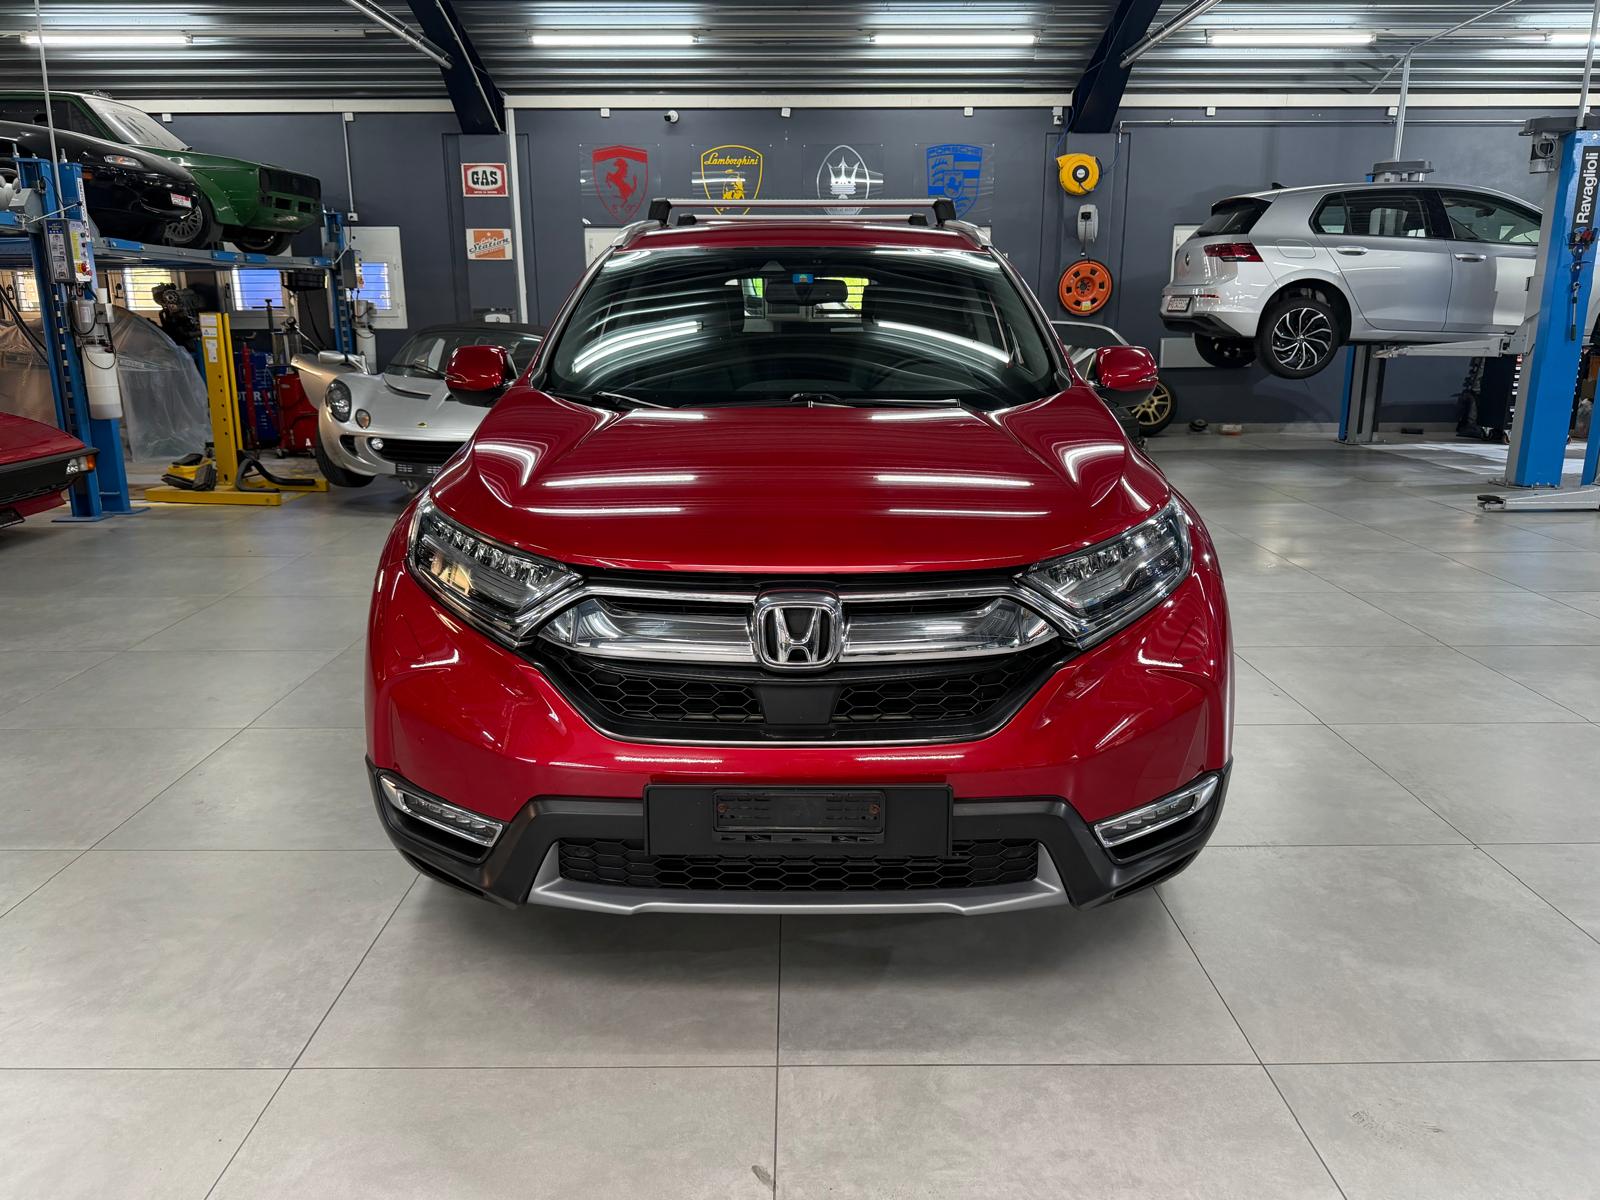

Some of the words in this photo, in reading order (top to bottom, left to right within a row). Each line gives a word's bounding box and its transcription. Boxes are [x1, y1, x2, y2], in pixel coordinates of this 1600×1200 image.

[704, 152, 759, 168] Lamborghini
[471, 170, 498, 186] GAS
[1576, 152, 1599, 223] Ravaglioli
